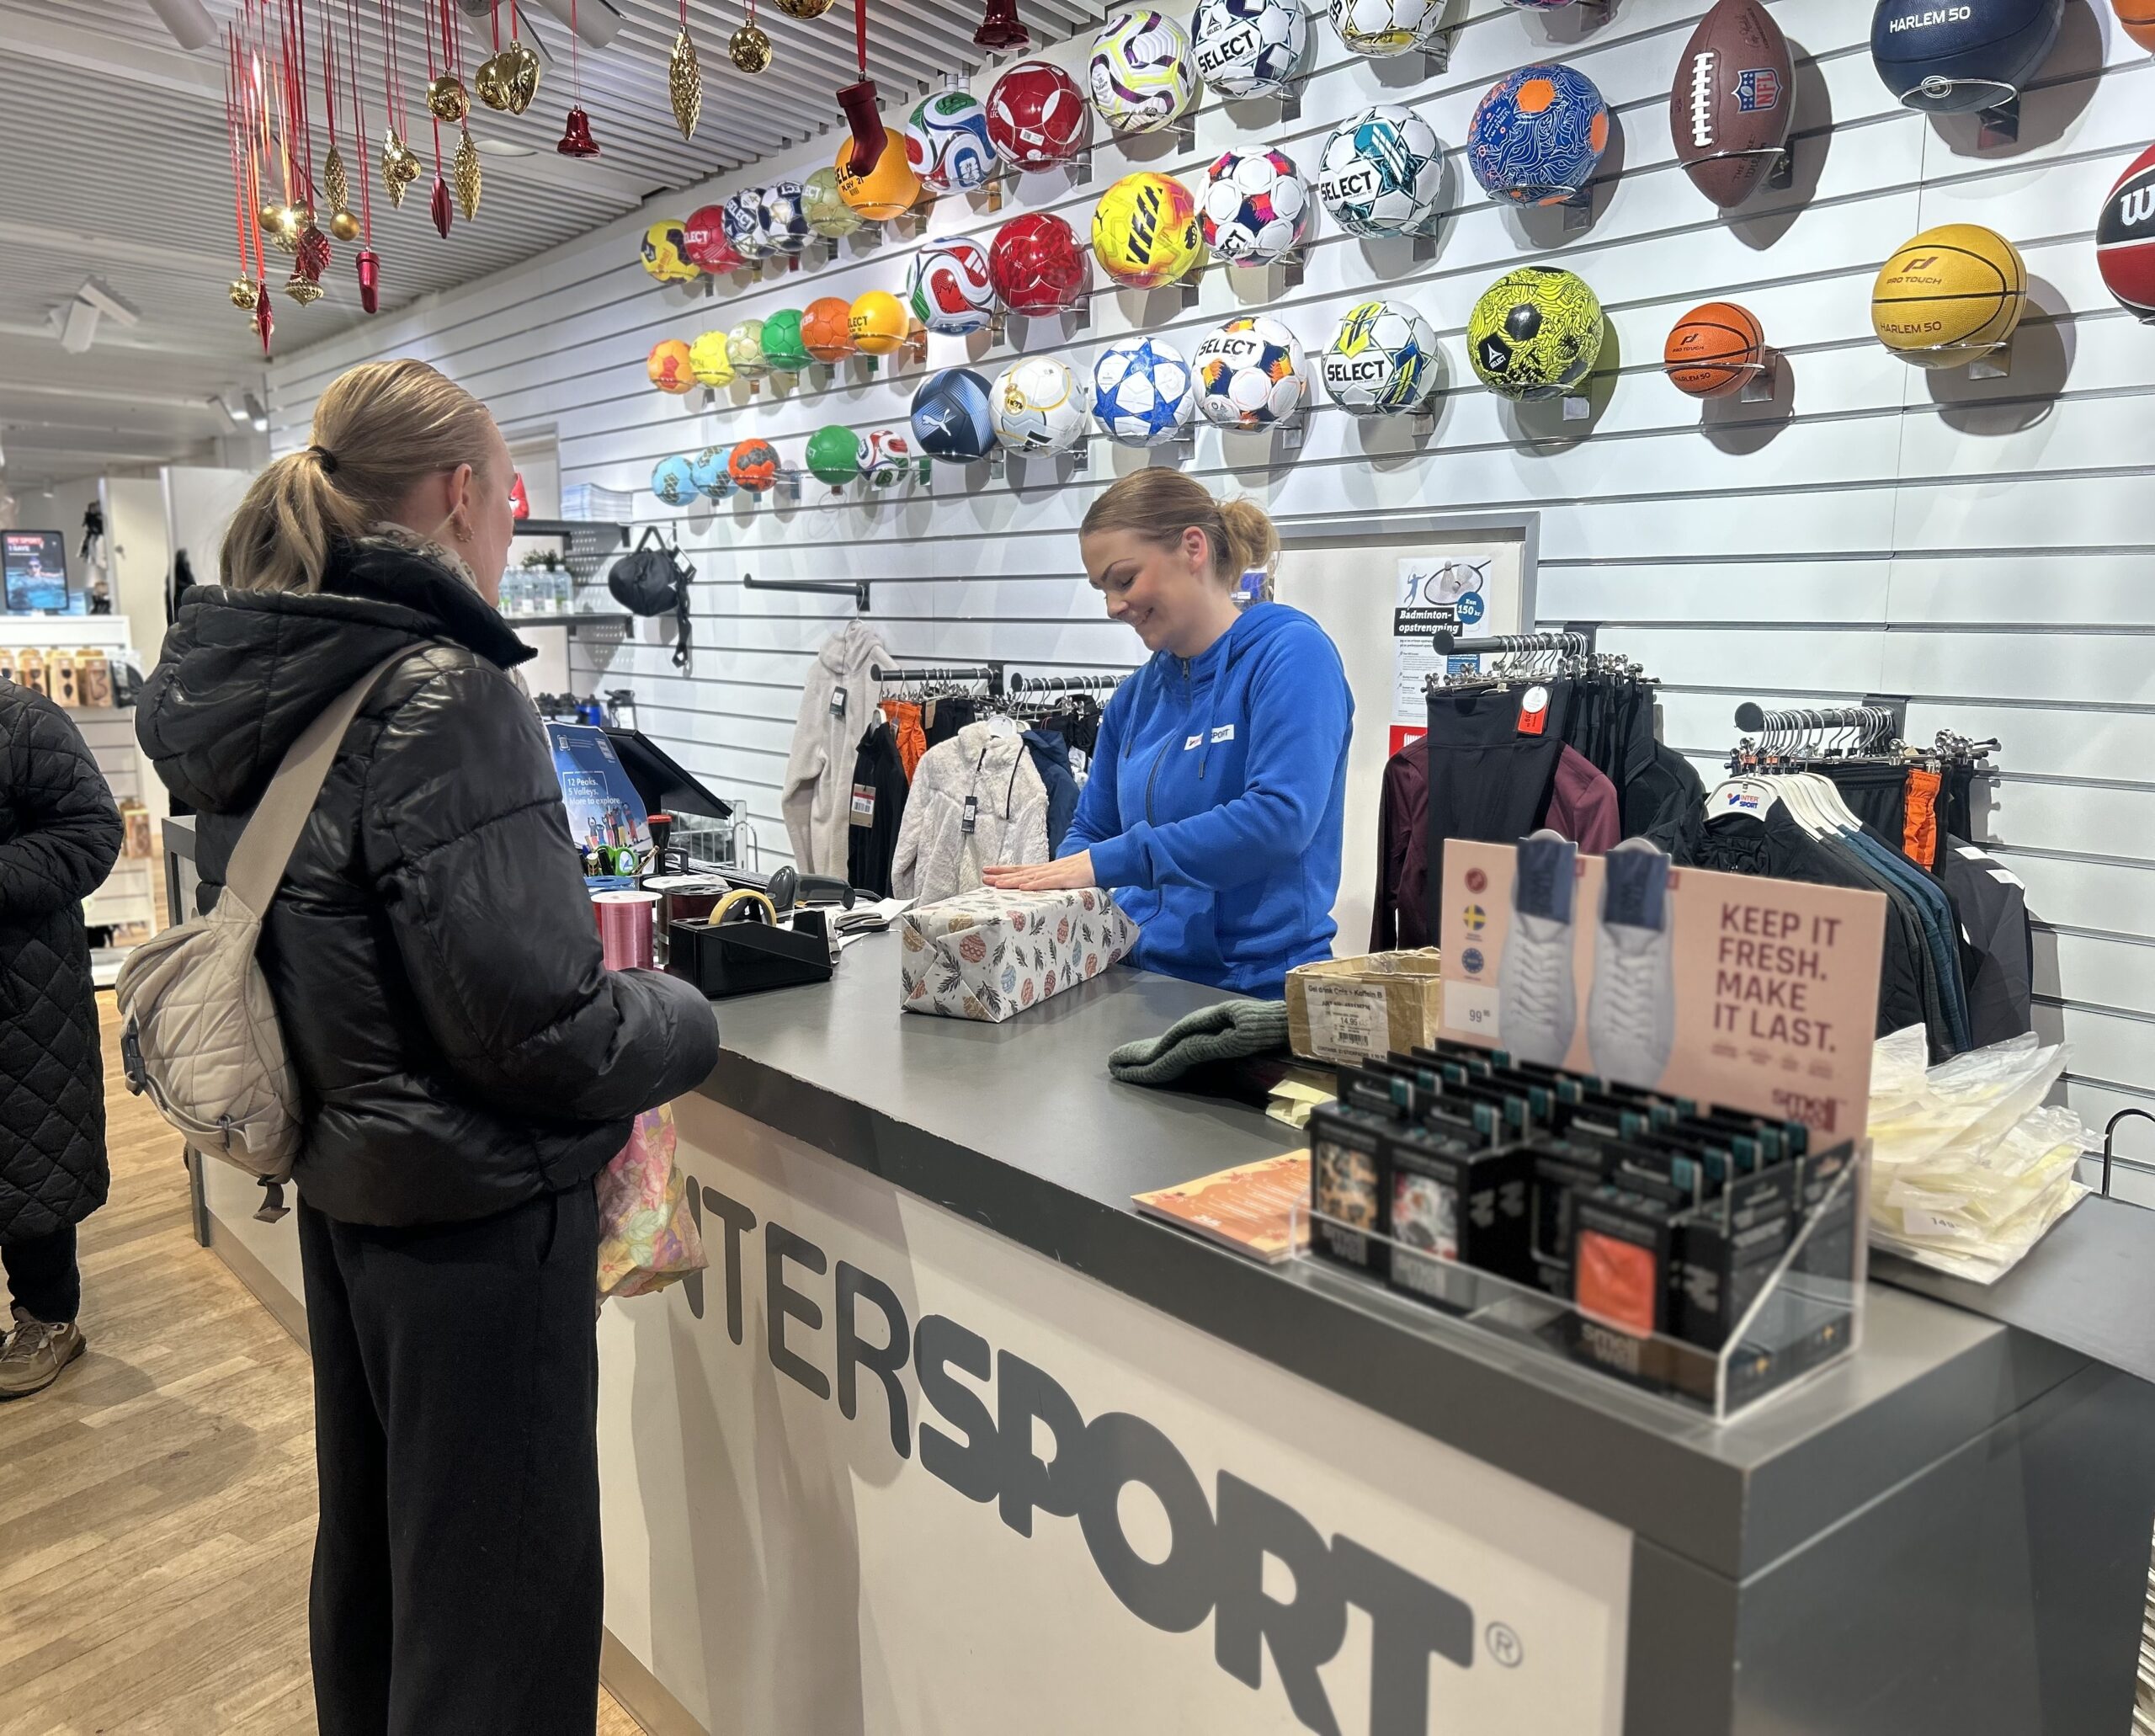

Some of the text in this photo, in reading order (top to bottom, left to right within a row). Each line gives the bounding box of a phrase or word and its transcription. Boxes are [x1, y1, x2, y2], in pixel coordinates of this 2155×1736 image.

[1889, 6, 1971, 33] HARLEM 50
[1206, 24, 1222, 36] SELECT
[1198, 29, 1254, 74] SELECT
[1756, 72, 1776, 107] NFL
[1321, 170, 1372, 201] SELECT
[726, 200, 755, 230] SELECT
[1905, 276, 1942, 285] TOUCH
[1880, 321, 1942, 334] HARLEM 50
[1198, 339, 1257, 356] SELECT
[1489, 354, 1507, 370] SELECT
[1328, 359, 1385, 382] SELECT
[1400, 610, 1452, 620] Badminton-
[1458, 605, 1474, 615] 150
[1398, 623, 1460, 634] opstrengning
[576, 778, 599, 786] Peaks.
[574, 788, 599, 798] Valleys.
[595, 796, 623, 807] explore.
[1721, 903, 1842, 947] KEEP IT
[1718, 935, 1828, 982] FRESH.
[1716, 970, 1807, 1012] MAKE
[1469, 1009, 1482, 1024] 99
[1713, 1002, 1741, 1033] IT
[1749, 1008, 1836, 1054] LAST.
